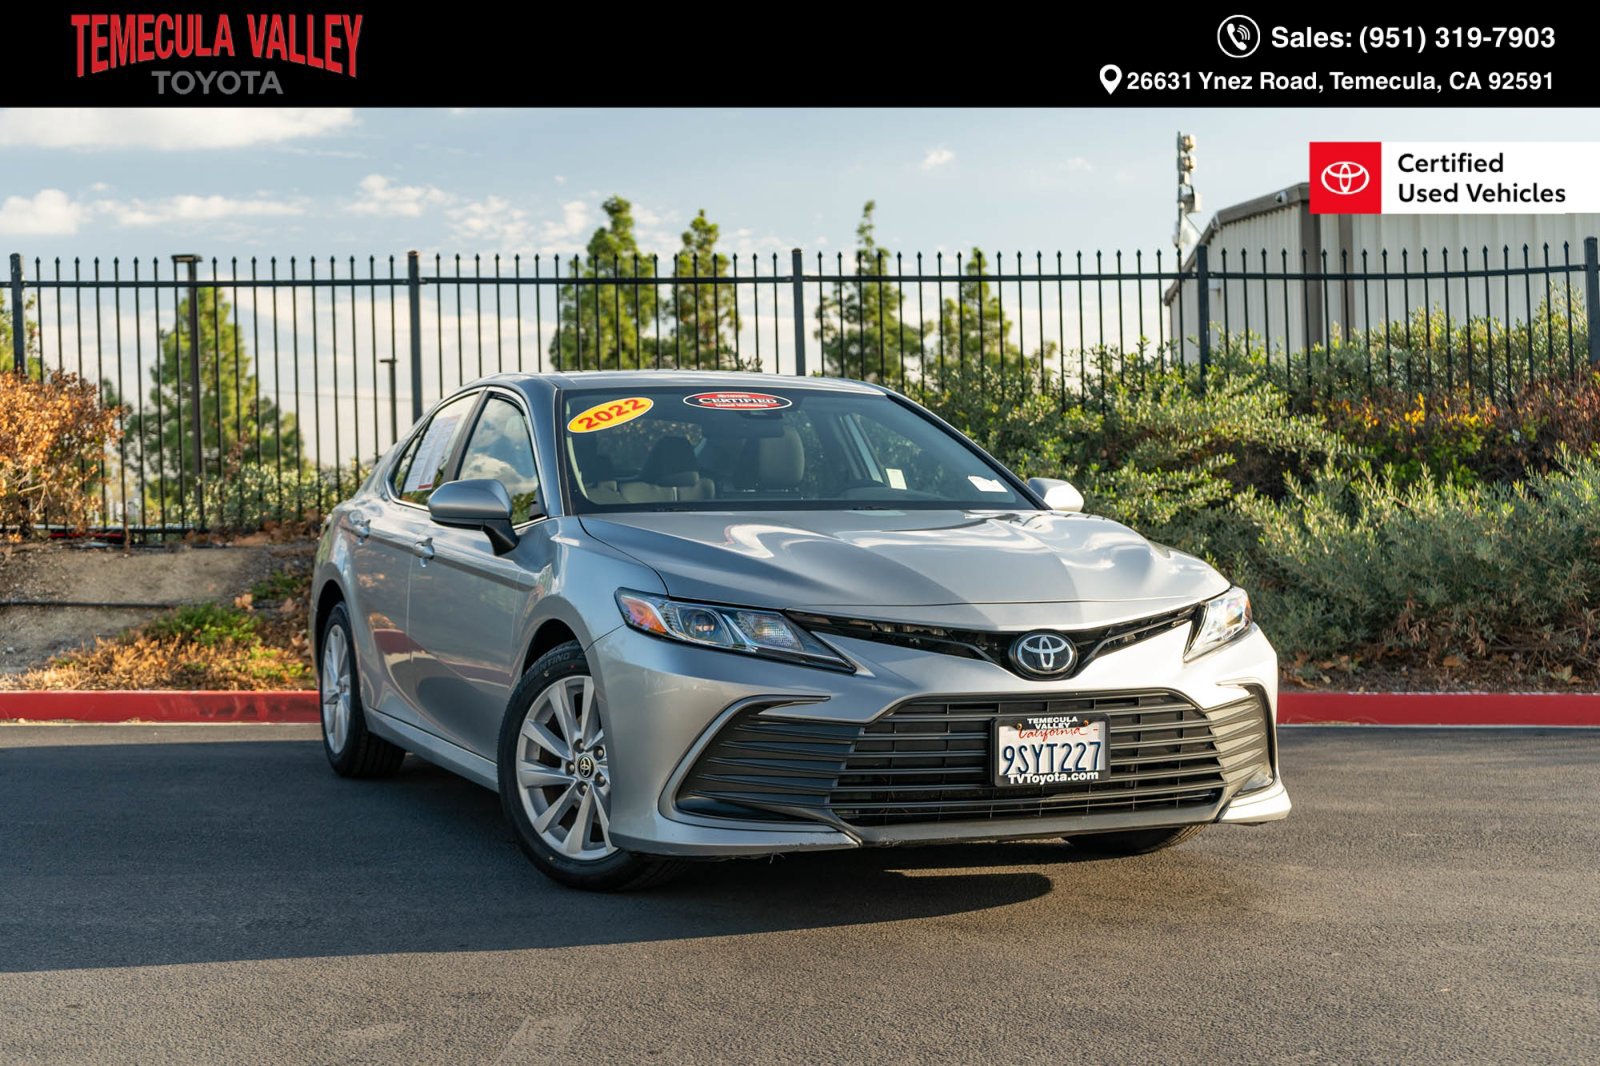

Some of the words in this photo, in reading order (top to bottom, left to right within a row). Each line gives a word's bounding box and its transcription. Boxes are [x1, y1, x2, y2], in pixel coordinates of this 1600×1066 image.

[698, 397, 778, 405] CERTIFIED
[578, 399, 645, 430] 2022
[1027, 716, 1078, 724] TEMECULA
[1003, 741, 1101, 775] 9SYT227
[1008, 771, 1099, 785] TVToyota.com
